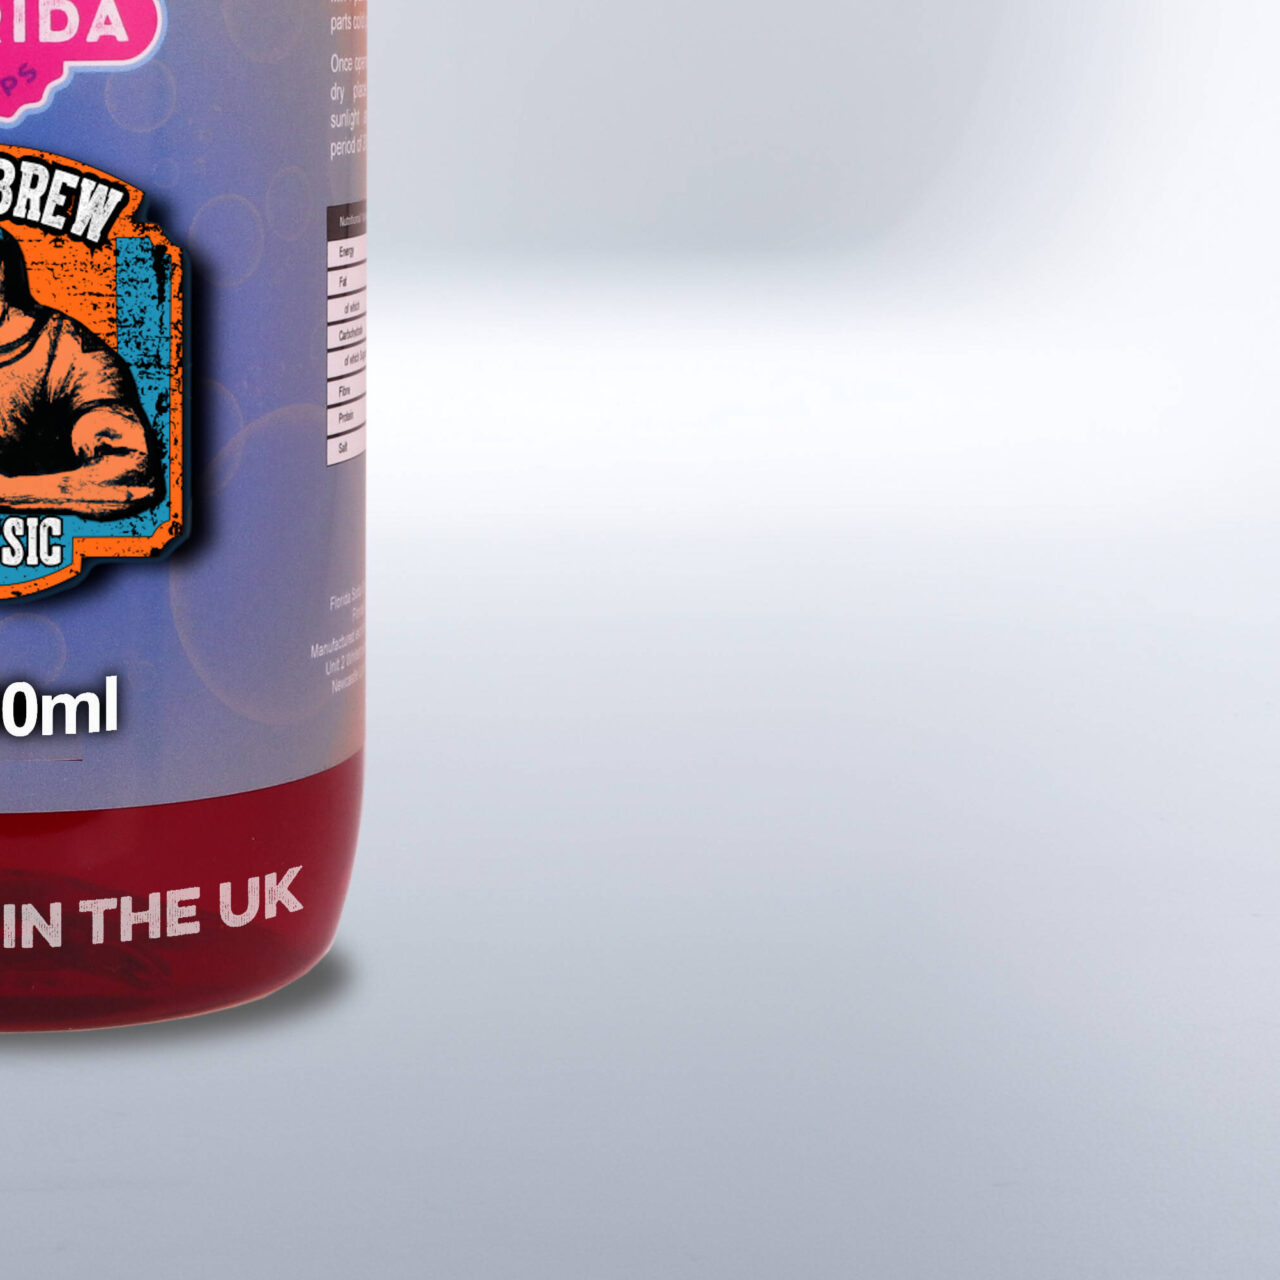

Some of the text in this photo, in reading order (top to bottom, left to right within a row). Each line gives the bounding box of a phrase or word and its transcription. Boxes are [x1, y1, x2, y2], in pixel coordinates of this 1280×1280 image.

[330, 13, 352, 36] parts
[330, 53, 353, 73] Once
[330, 82, 345, 105] dry
[330, 136, 356, 161] period
[2, 901, 63, 950] IN
[79, 887, 201, 946] THE
[219, 865, 305, 929] UK
